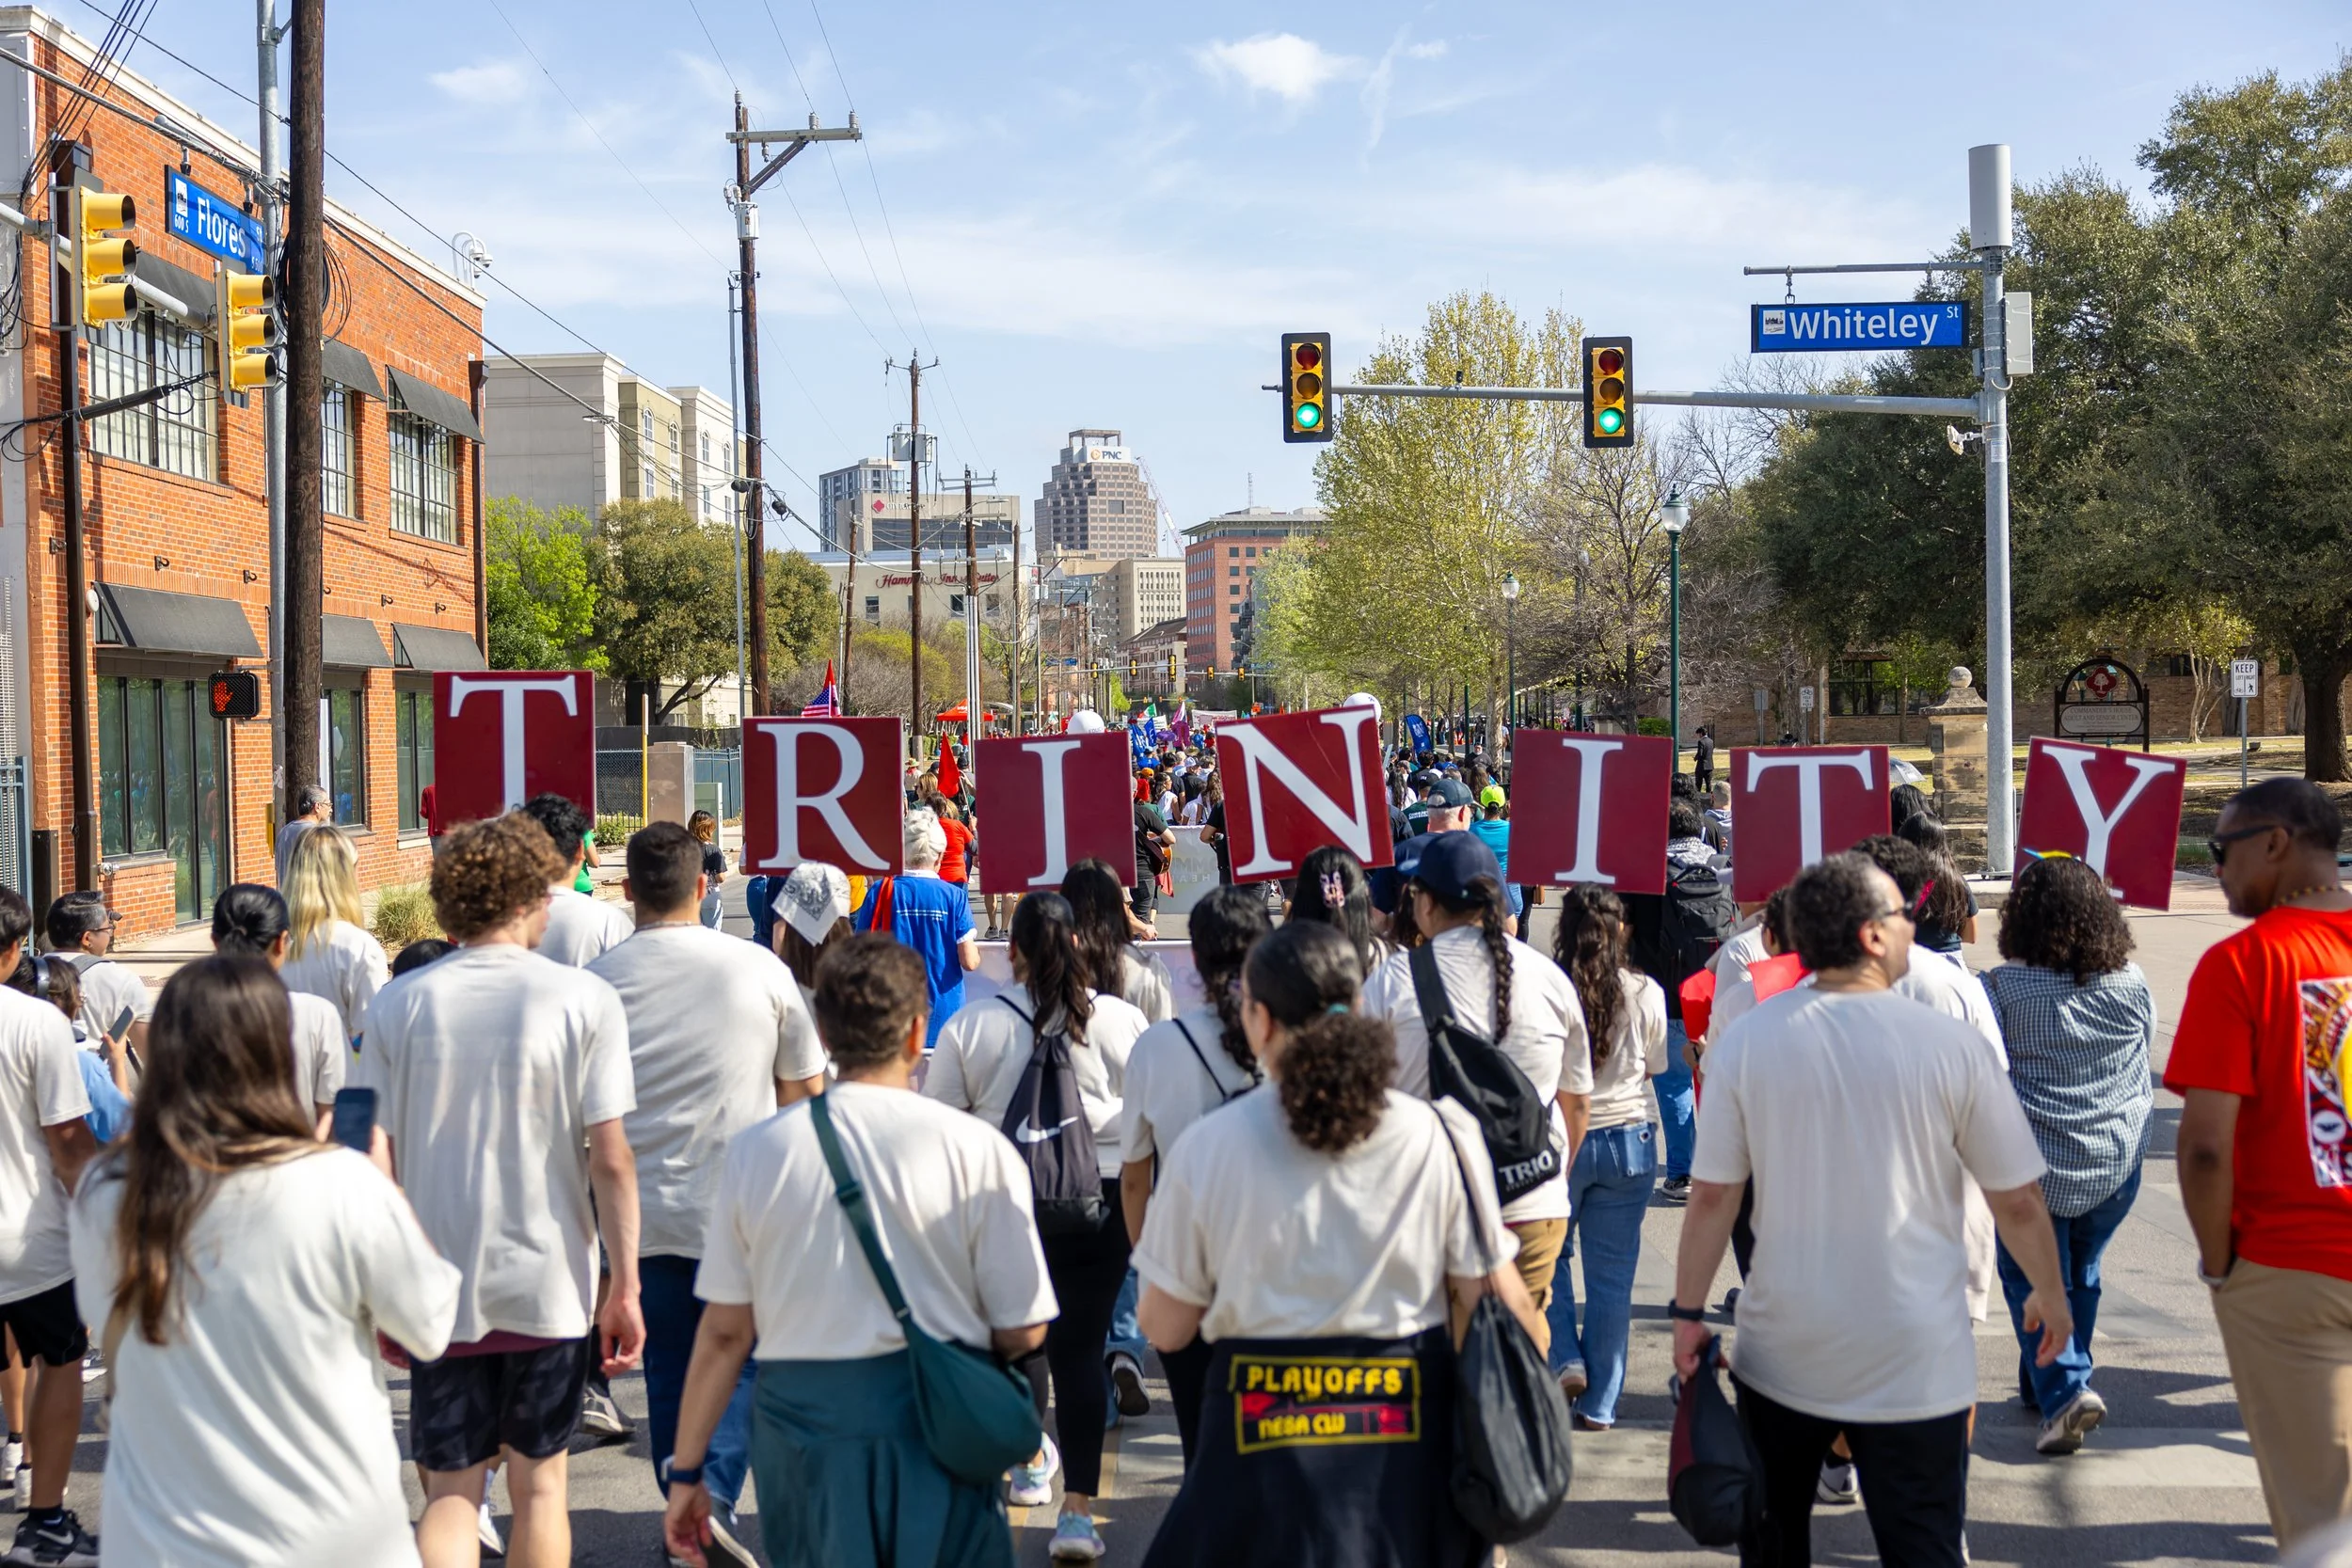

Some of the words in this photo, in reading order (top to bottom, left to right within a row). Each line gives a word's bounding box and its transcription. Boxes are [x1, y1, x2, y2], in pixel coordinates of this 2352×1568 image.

[197, 197, 246, 258] Flores
[1789, 309, 1938, 345] Whiteley
[1947, 306, 1959, 319] St
[1102, 451, 1121, 460] PNC
[2235, 663, 2254, 673] KEEP
[1498, 1149, 1553, 1184] TRIO
[1246, 1365, 1403, 1399] PLAYOFFS
